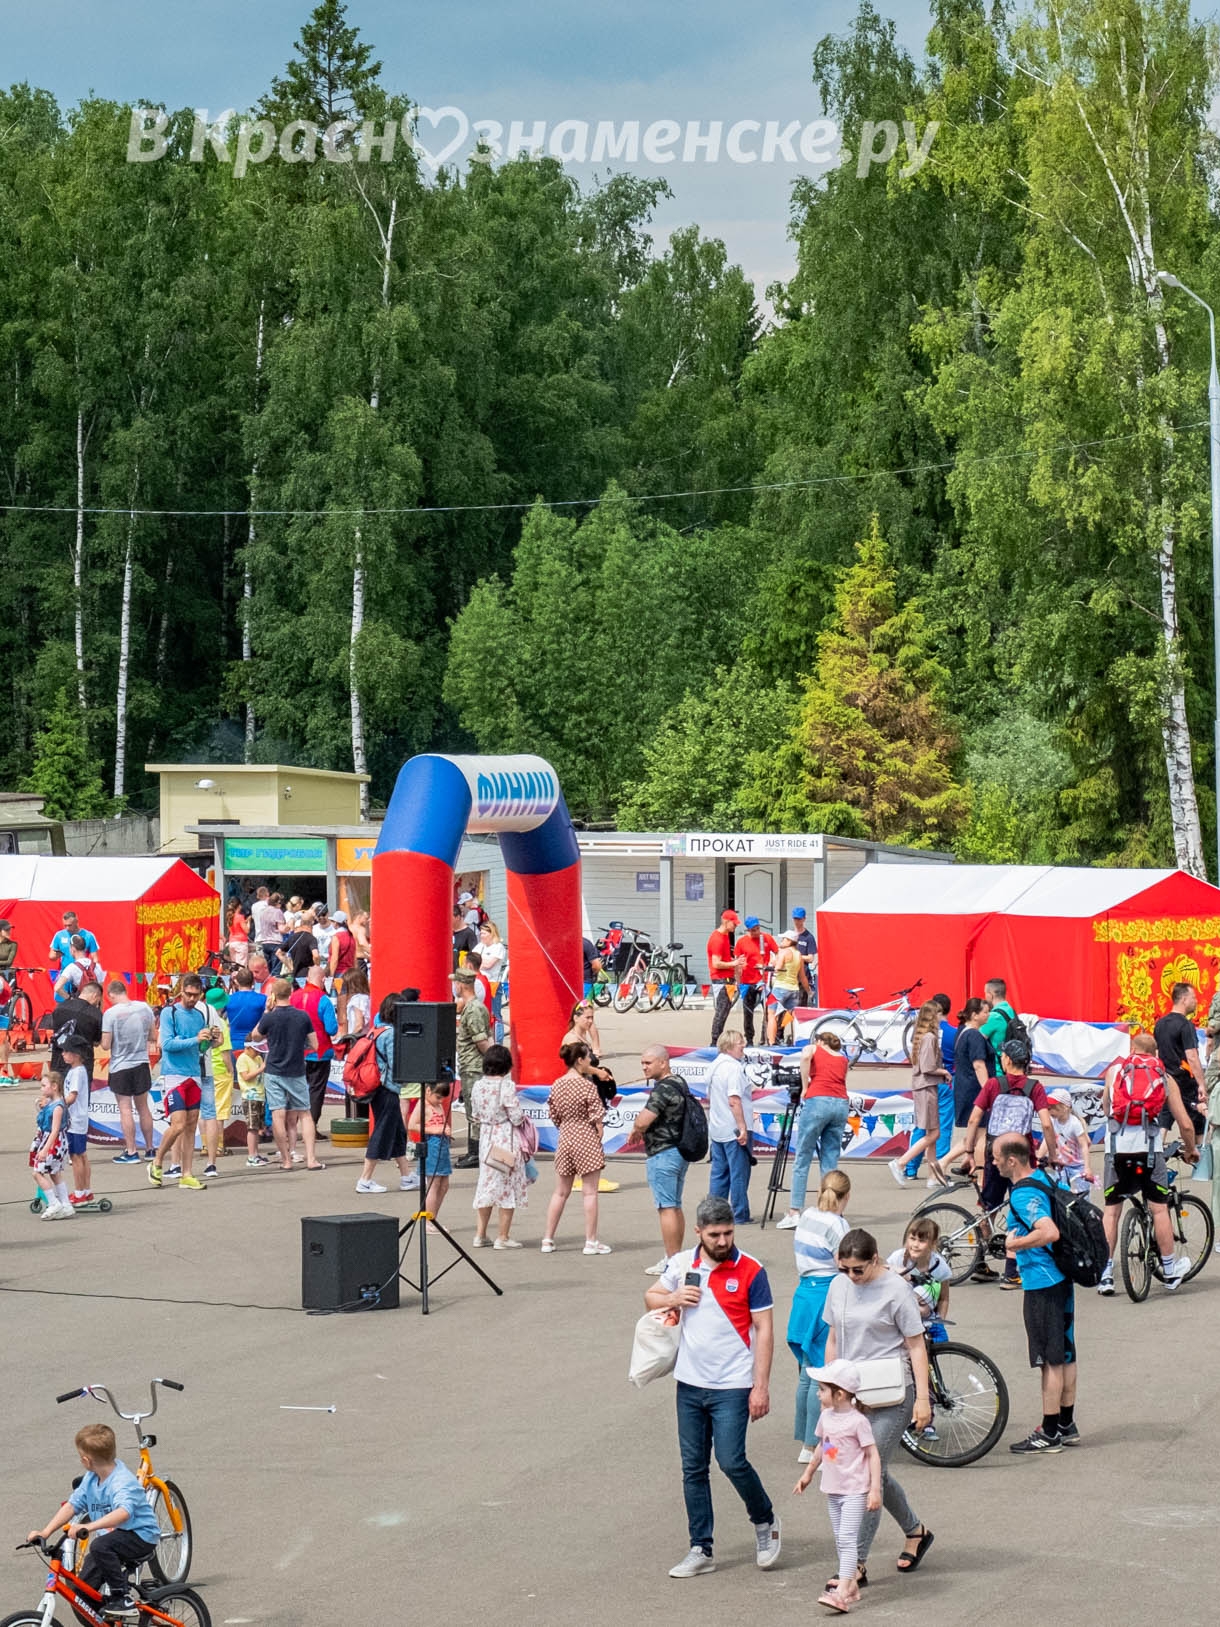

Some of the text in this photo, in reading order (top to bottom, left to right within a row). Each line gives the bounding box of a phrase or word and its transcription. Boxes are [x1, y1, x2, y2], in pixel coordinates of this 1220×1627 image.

[477, 771, 554, 817] ФИНИШ
[690, 838, 754, 852] ПРОКАТ
[764, 840, 785, 848] JUST
